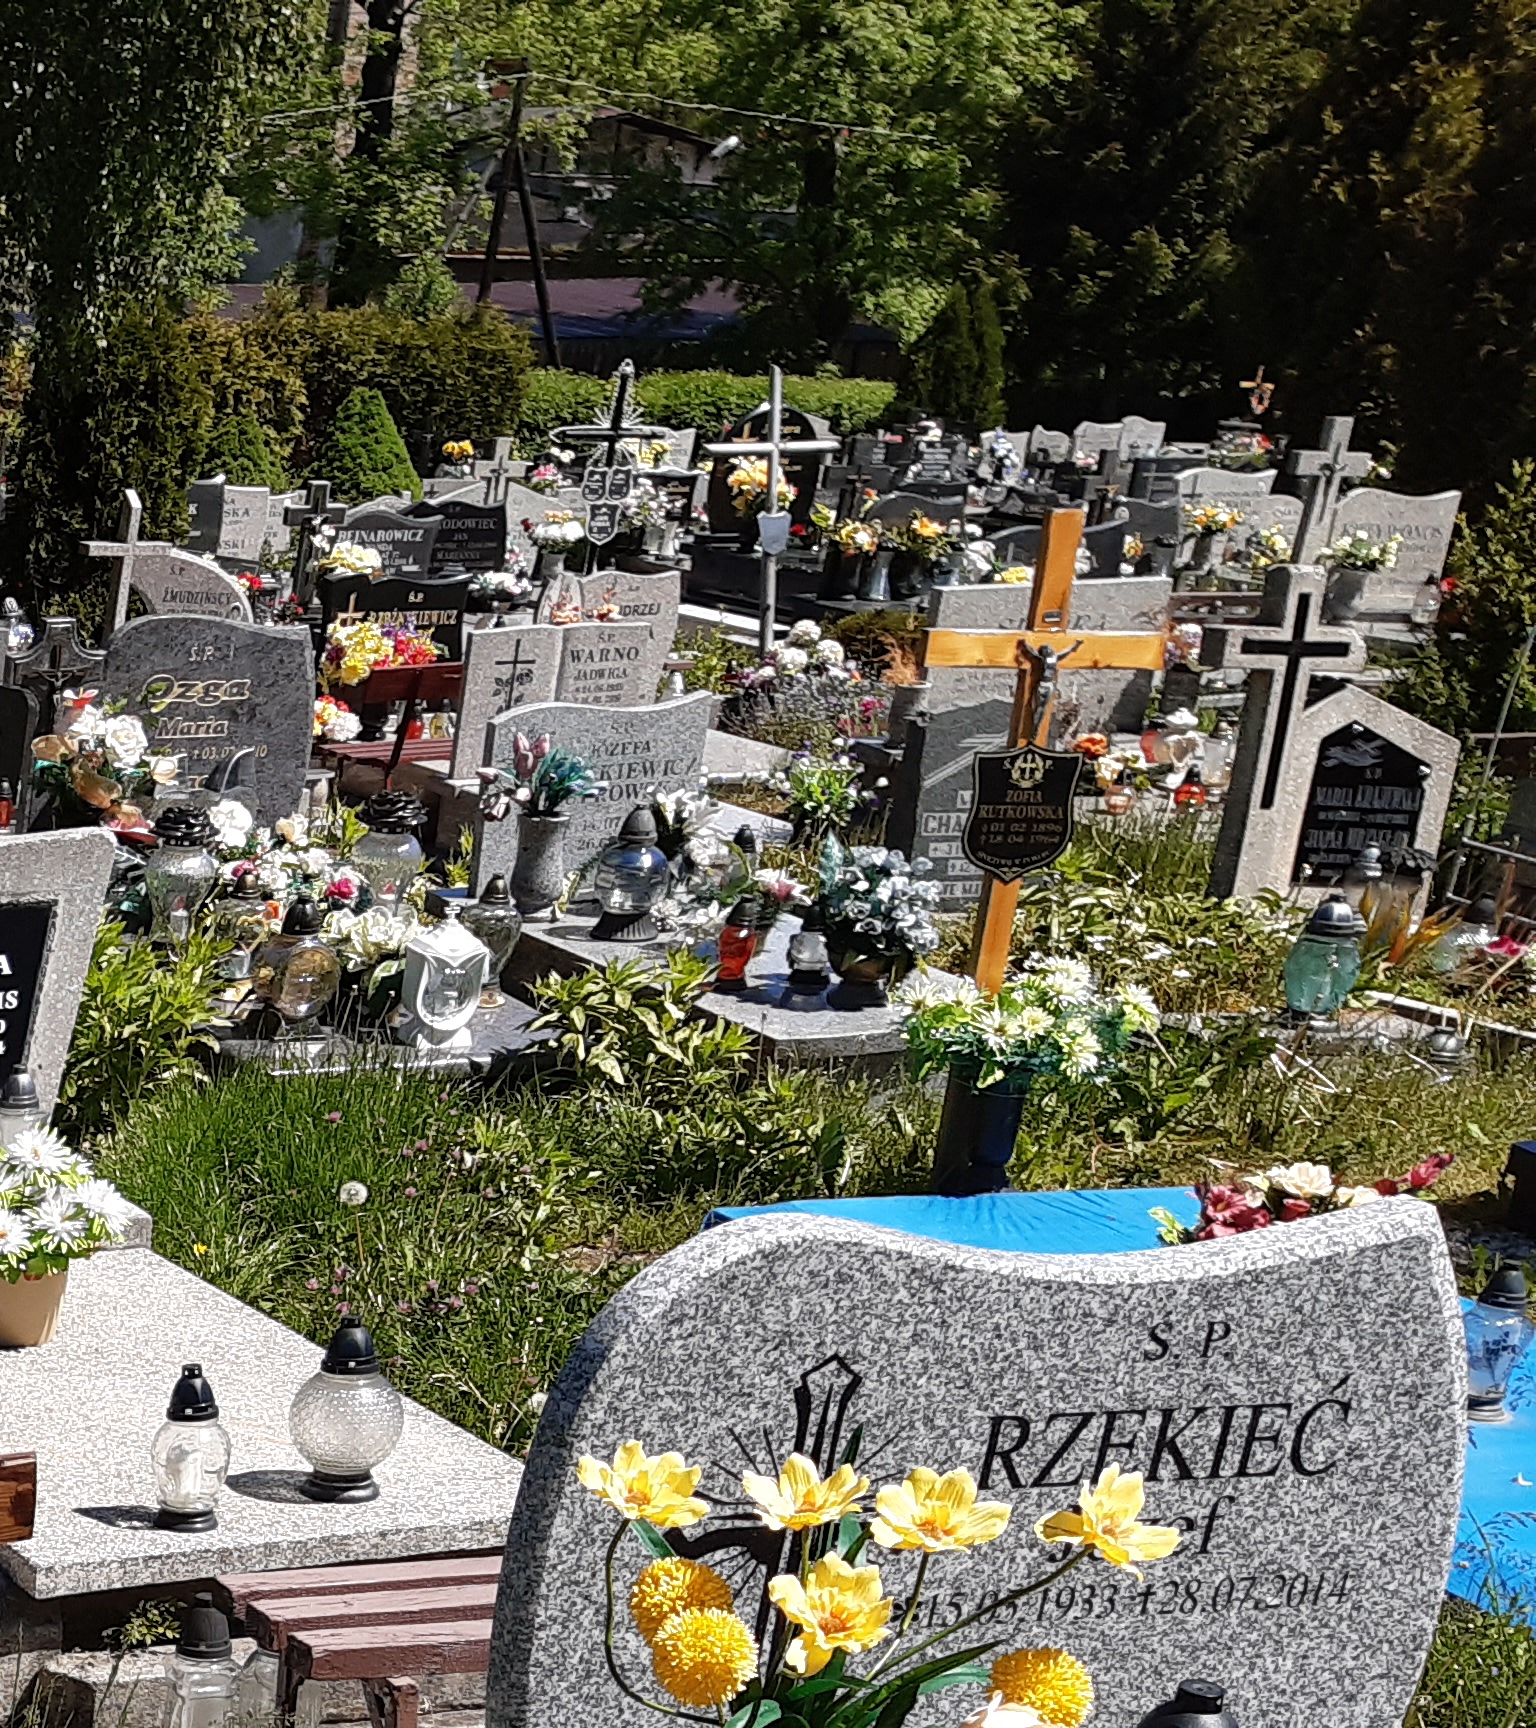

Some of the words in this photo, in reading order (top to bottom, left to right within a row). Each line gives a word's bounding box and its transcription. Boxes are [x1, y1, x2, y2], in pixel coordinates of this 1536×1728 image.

[570, 646, 640, 664] WARNO
[154, 715, 229, 740] Maria
[976, 1372, 1354, 1492] RZEKIEĆ
